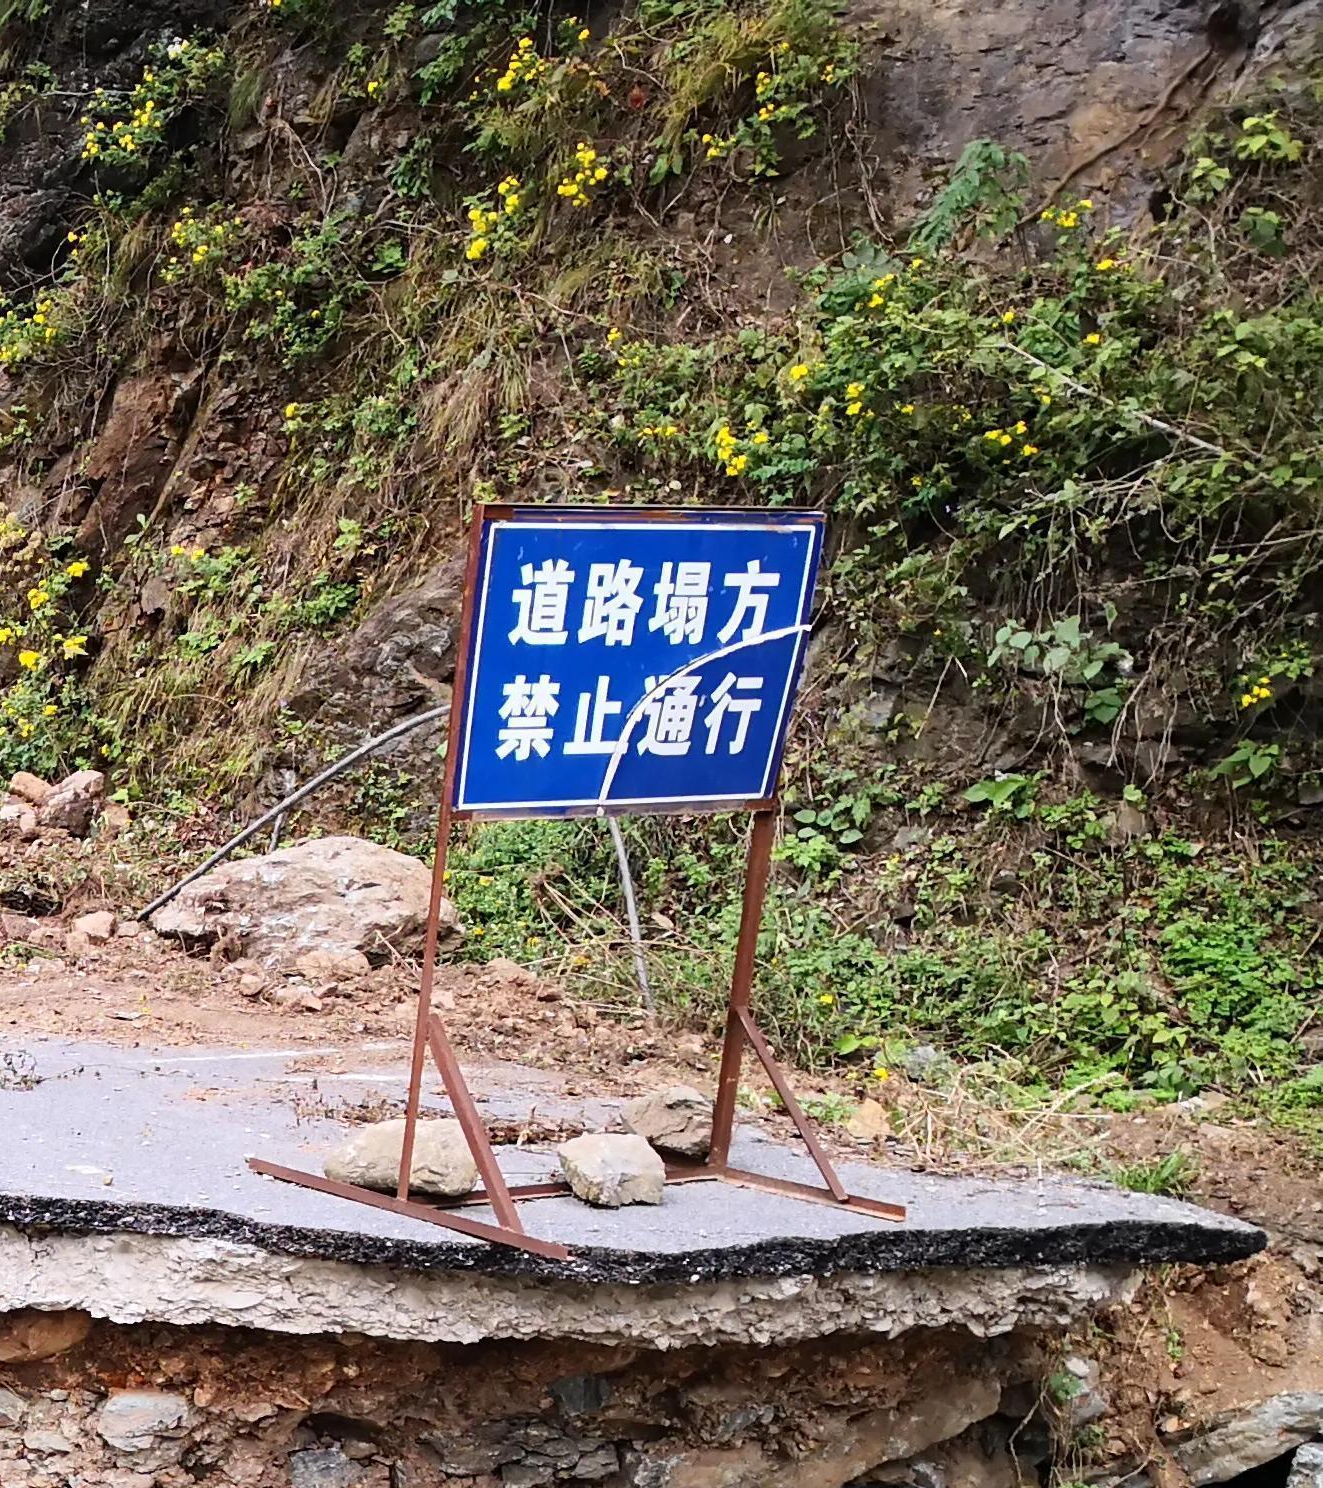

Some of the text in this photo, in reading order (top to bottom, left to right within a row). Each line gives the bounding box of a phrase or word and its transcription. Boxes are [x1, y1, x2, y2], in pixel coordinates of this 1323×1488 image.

[508, 558, 781, 647] 道路塌方
[495, 670, 763, 762] 禁止通行
